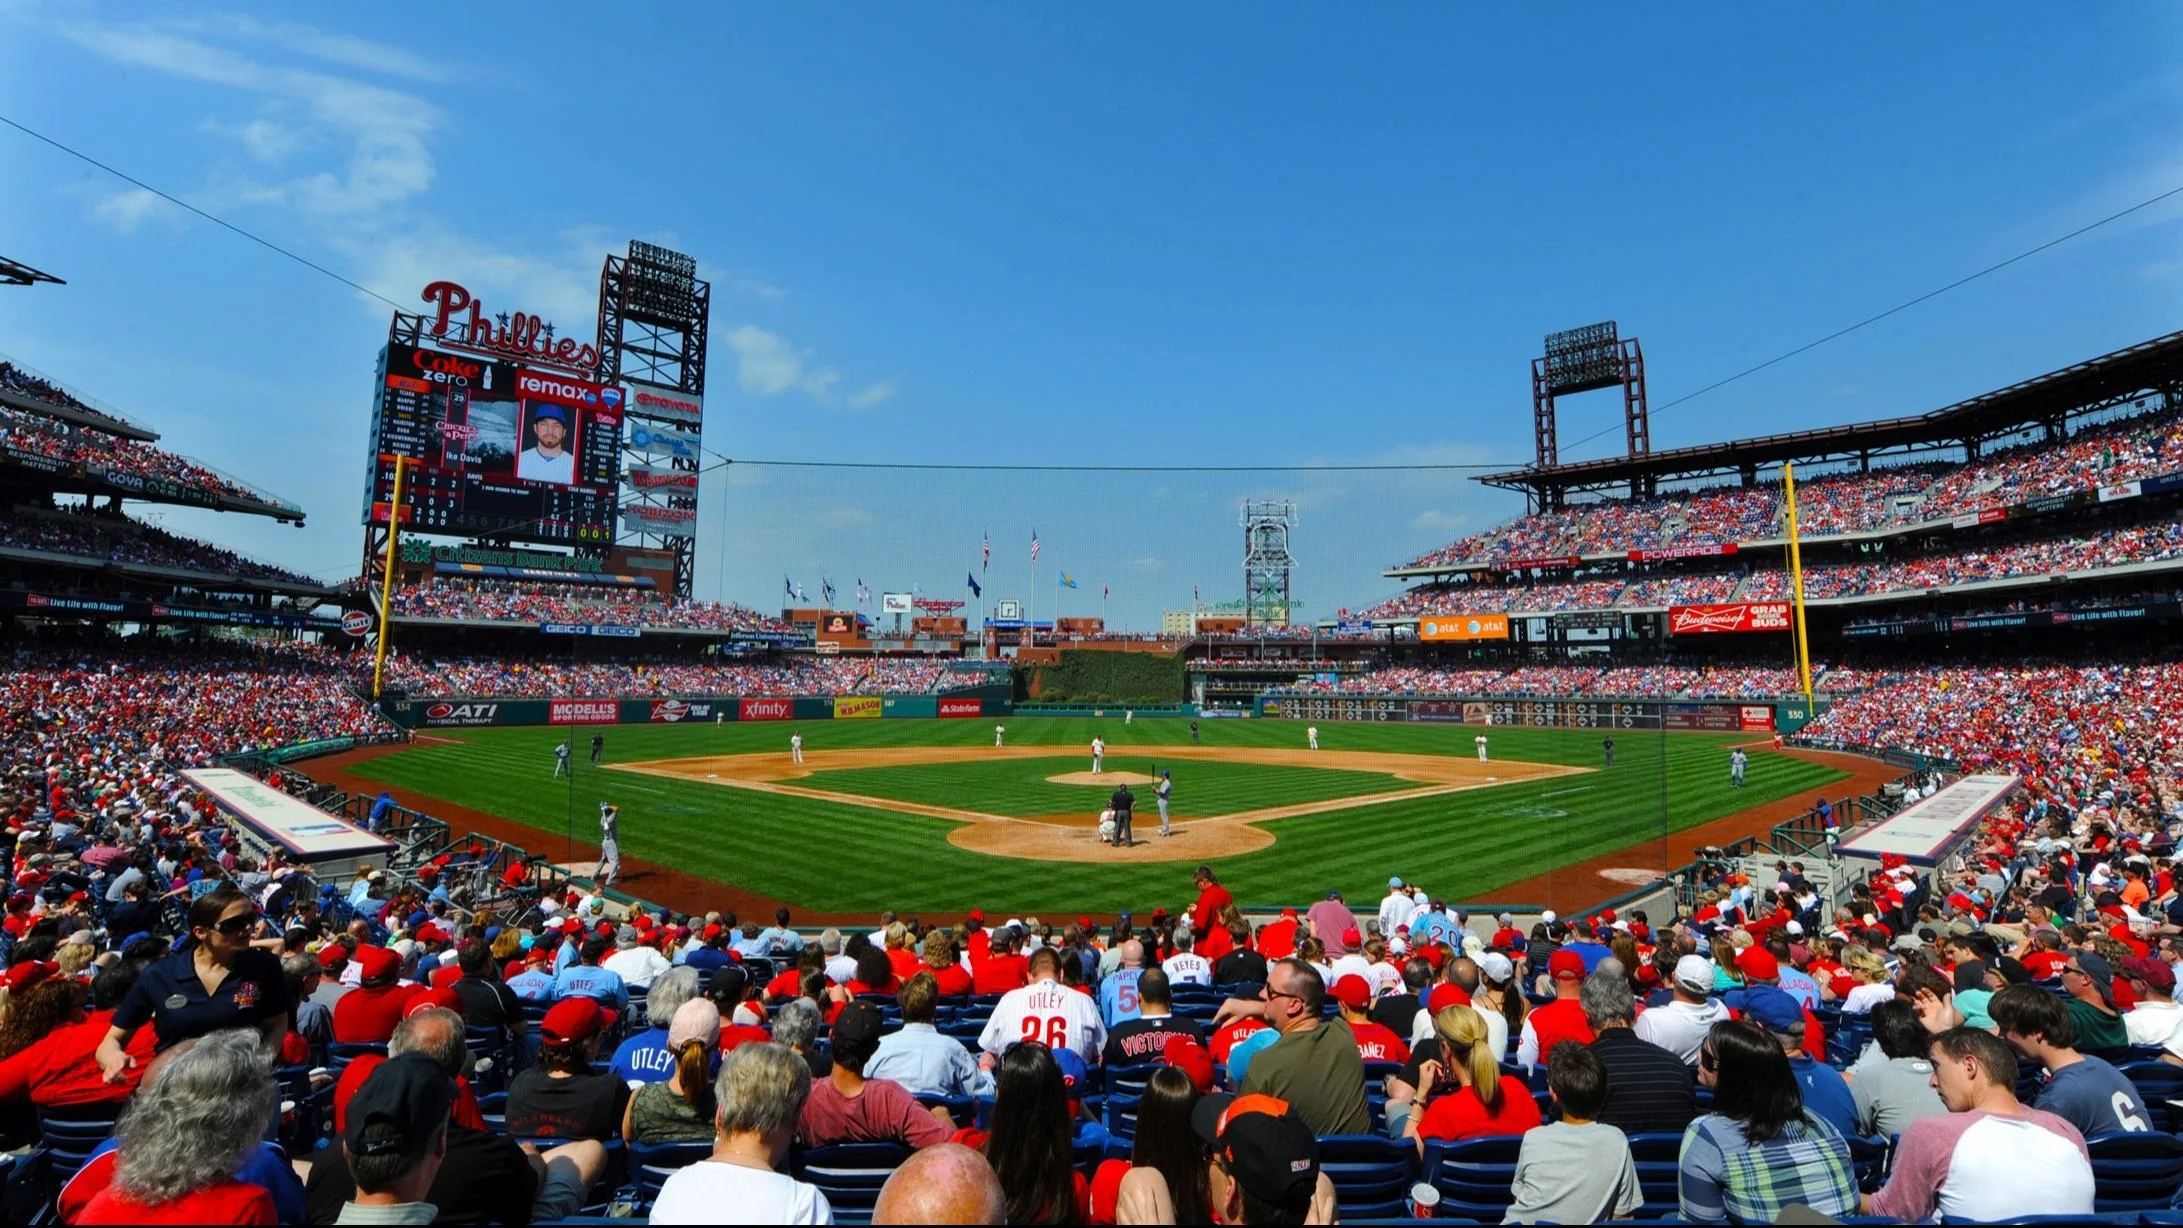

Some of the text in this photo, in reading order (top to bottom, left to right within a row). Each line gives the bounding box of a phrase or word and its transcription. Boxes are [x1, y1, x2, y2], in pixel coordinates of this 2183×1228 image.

[422, 280, 600, 369] Phillies
[413, 349, 480, 378] Coke
[422, 369, 468, 387] zero
[520, 376, 588, 401] remax
[8, 450, 71, 468] RESPONSIBILITY
[446, 451, 482, 464] Ike Davis
[21, 459, 57, 473] MATTERS
[107, 471, 144, 488] GOYA
[431, 477, 436, 486] 2
[451, 480, 457, 488] 2
[429, 497, 434, 505] 0
[441, 510, 447, 518] 0
[1979, 510, 1999, 520] Canon
[428, 517, 434, 525] 0
[440, 518, 446, 526] 0
[580, 528, 587, 538] 0
[592, 529, 599, 539] 0
[1642, 545, 1723, 559] POWERADE
[435, 545, 602, 573] Citizens Bank Park
[50, 598, 66, 608] Live
[67, 600, 81, 608] Life
[82, 600, 98, 610] with
[99, 602, 124, 611] Flavor!
[1751, 605, 1788, 614] GRAB
[170, 608, 183, 616] Live
[209, 612, 229, 620] Flavor!
[1673, 612, 1745, 627] Budweiser
[2071, 613, 2086, 621] Live
[2087, 611, 2101, 619] Life
[2102, 610, 2118, 618] with
[2119, 608, 2145, 617] Flavor!
[343, 619, 369, 630] Gulf
[1439, 621, 1504, 633] at&t at&t
[1751, 618, 1788, 628] BUDS
[2005, 617, 2026, 625] Flavor!
[546, 625, 635, 636] GEICO GEICO
[730, 632, 808, 641] Jefferson University Hospitals
[452, 704, 498, 718] ATI
[553, 704, 616, 714] MODELL'S
[746, 702, 788, 715] xfinity
[553, 713, 617, 721] SPORTING GOODS
[1173, 960, 1201, 972] REYES
[1029, 993, 1064, 1009] UTLEY
[1118, 985, 1138, 1013] 5
[1021, 1015, 1067, 1048] 26
[1233, 1029, 1257, 1040] UTLE
[1121, 1031, 1195, 1057] VICTO
[632, 1047, 675, 1073] UTLEY
